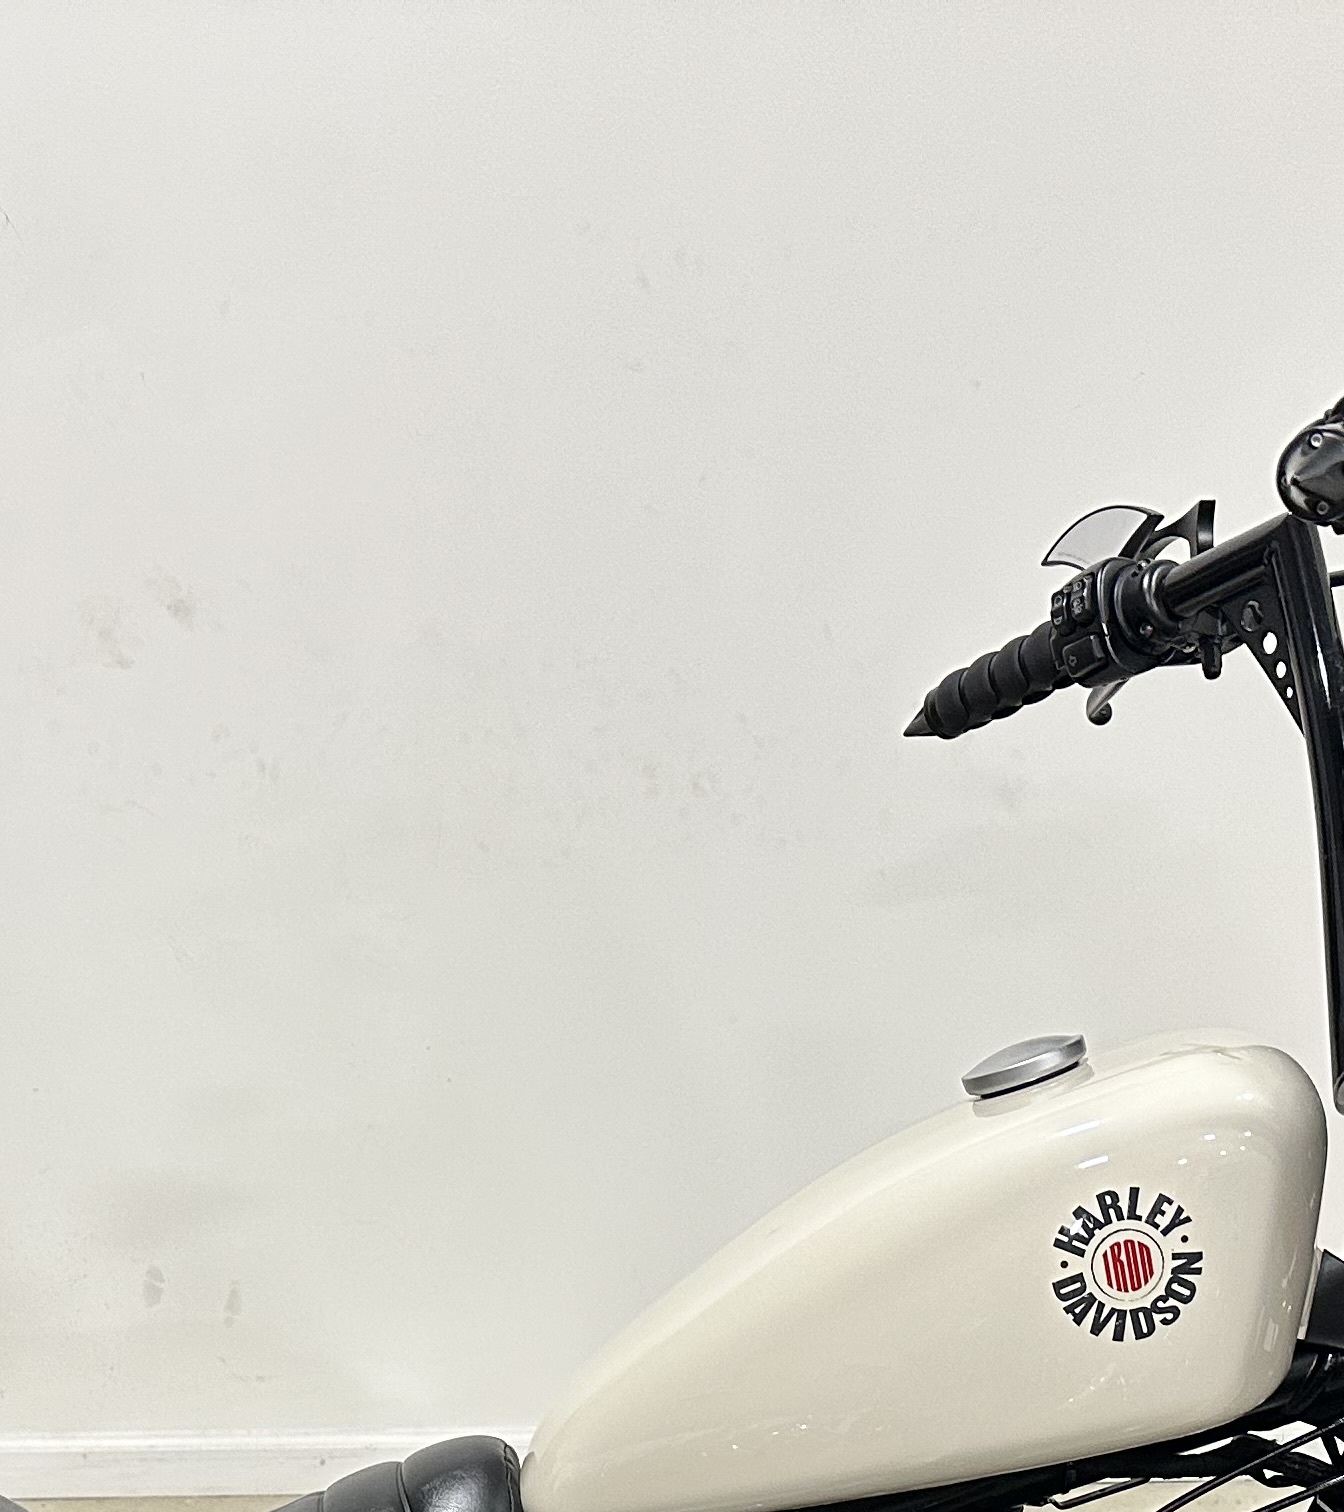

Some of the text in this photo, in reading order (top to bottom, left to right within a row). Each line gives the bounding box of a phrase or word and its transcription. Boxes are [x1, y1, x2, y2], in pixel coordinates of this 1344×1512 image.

[1053, 1187, 1192, 1258] HARLEY
[1052, 1251, 1203, 1342] DAVIDSON
[1102, 1239, 1155, 1293] IRON
